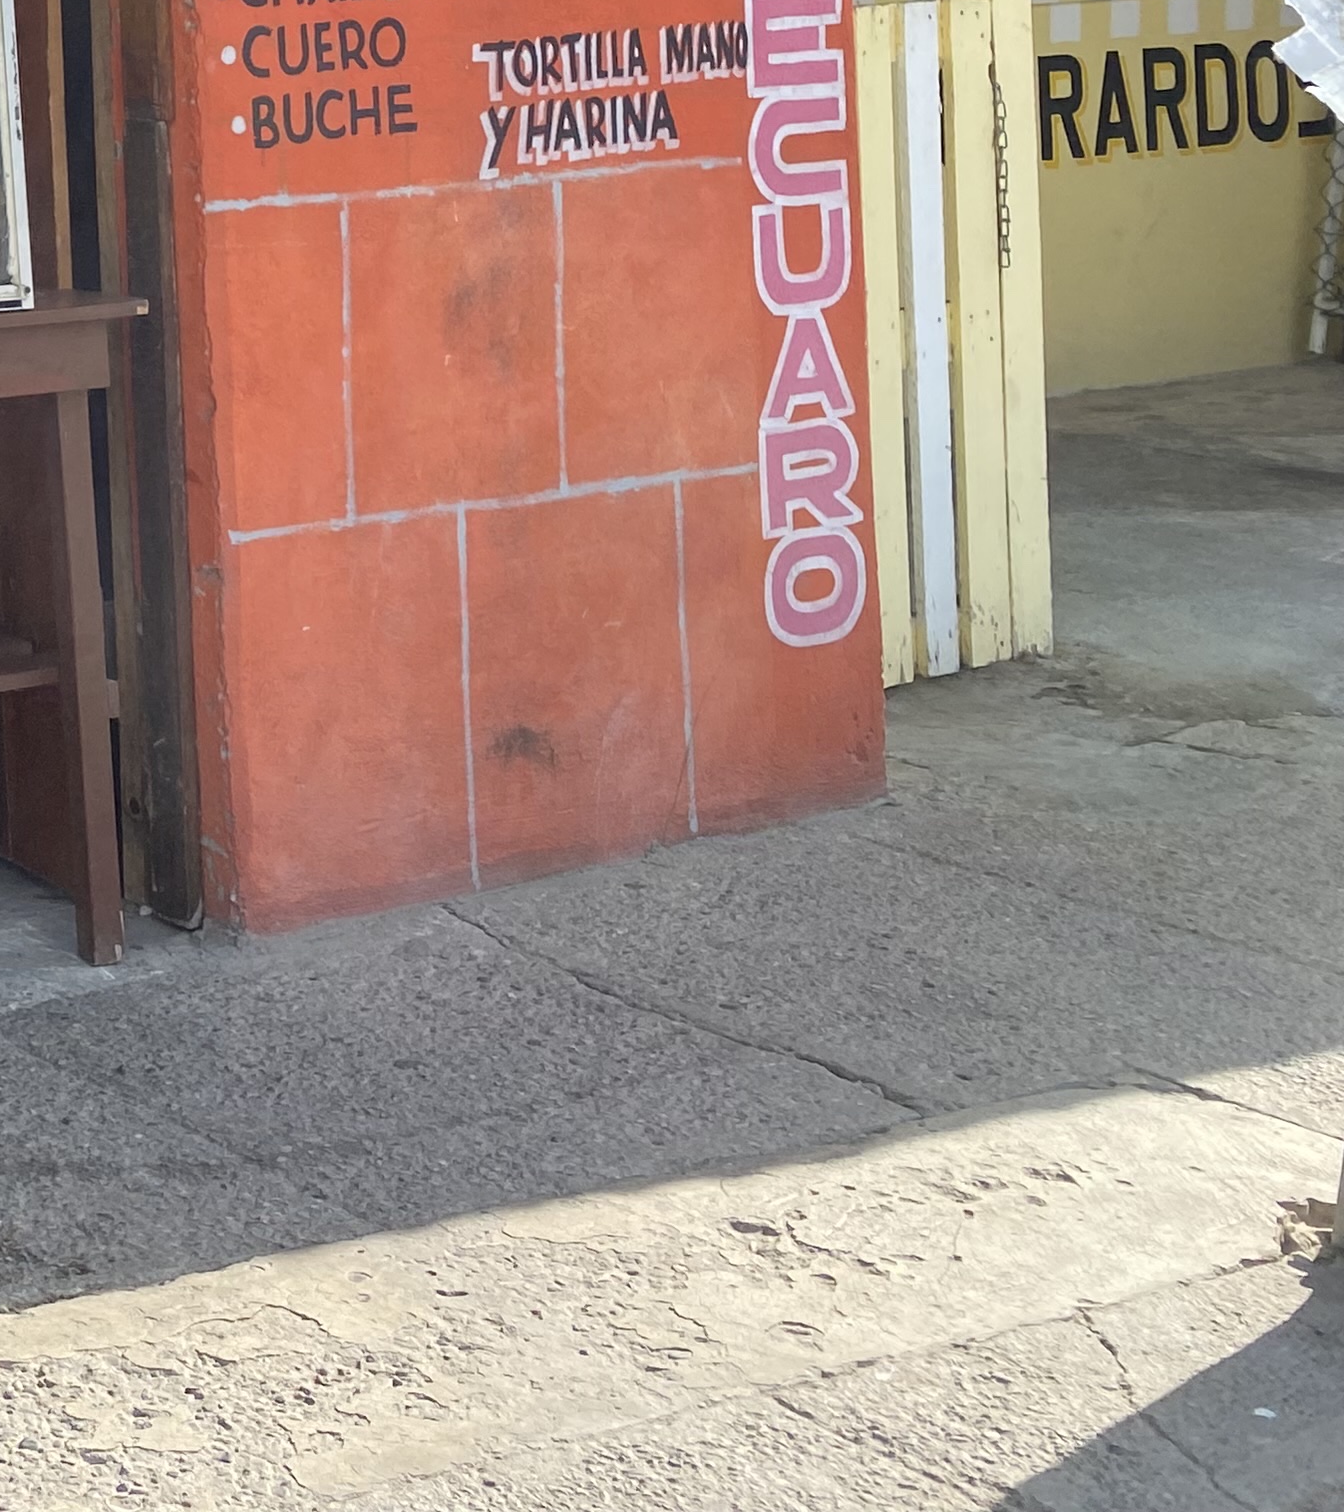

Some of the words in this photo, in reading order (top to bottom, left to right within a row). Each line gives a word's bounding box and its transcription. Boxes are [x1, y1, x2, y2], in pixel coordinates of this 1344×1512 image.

[241, 16, 407, 79] CUERO
[473, 28, 650, 102] TORTILLA
[659, 18, 749, 80] MANO
[251, 84, 418, 149] BUCHE
[480, 105, 518, 180] Y
[517, 90, 680, 165] HARINA
